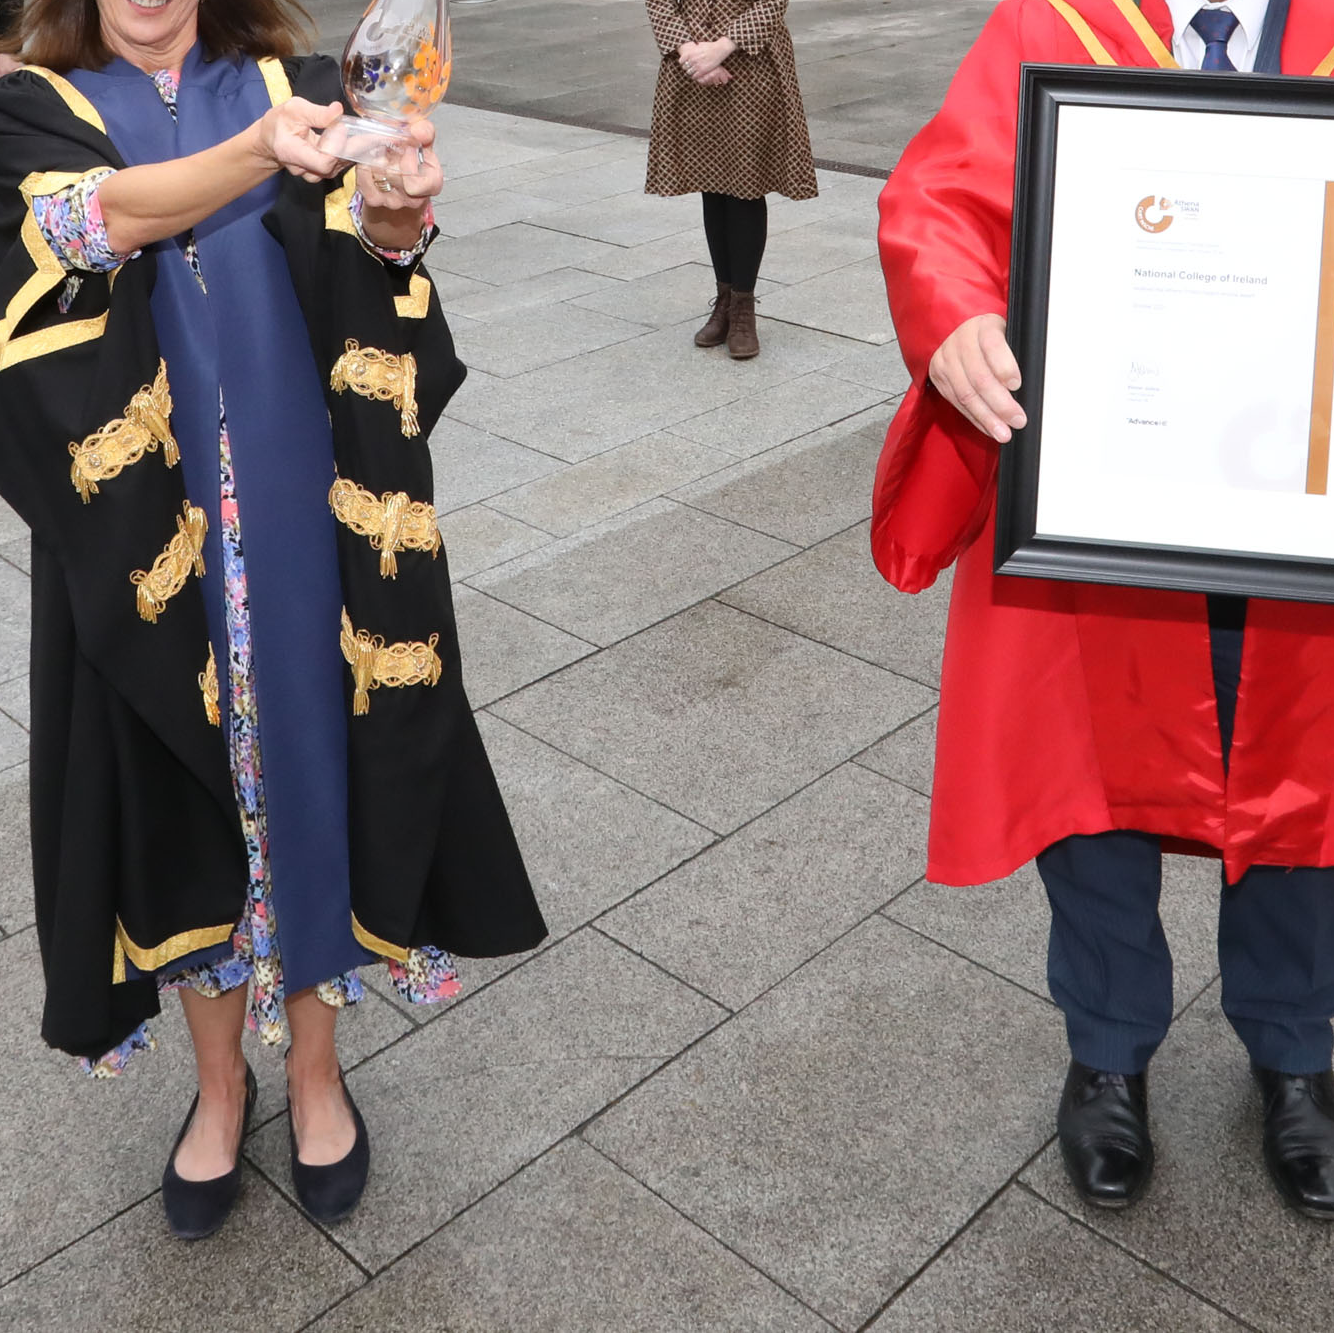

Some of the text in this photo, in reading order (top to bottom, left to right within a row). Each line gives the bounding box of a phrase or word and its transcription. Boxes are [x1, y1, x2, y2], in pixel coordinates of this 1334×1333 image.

[1134, 268, 1268, 285] National College of Ireland
